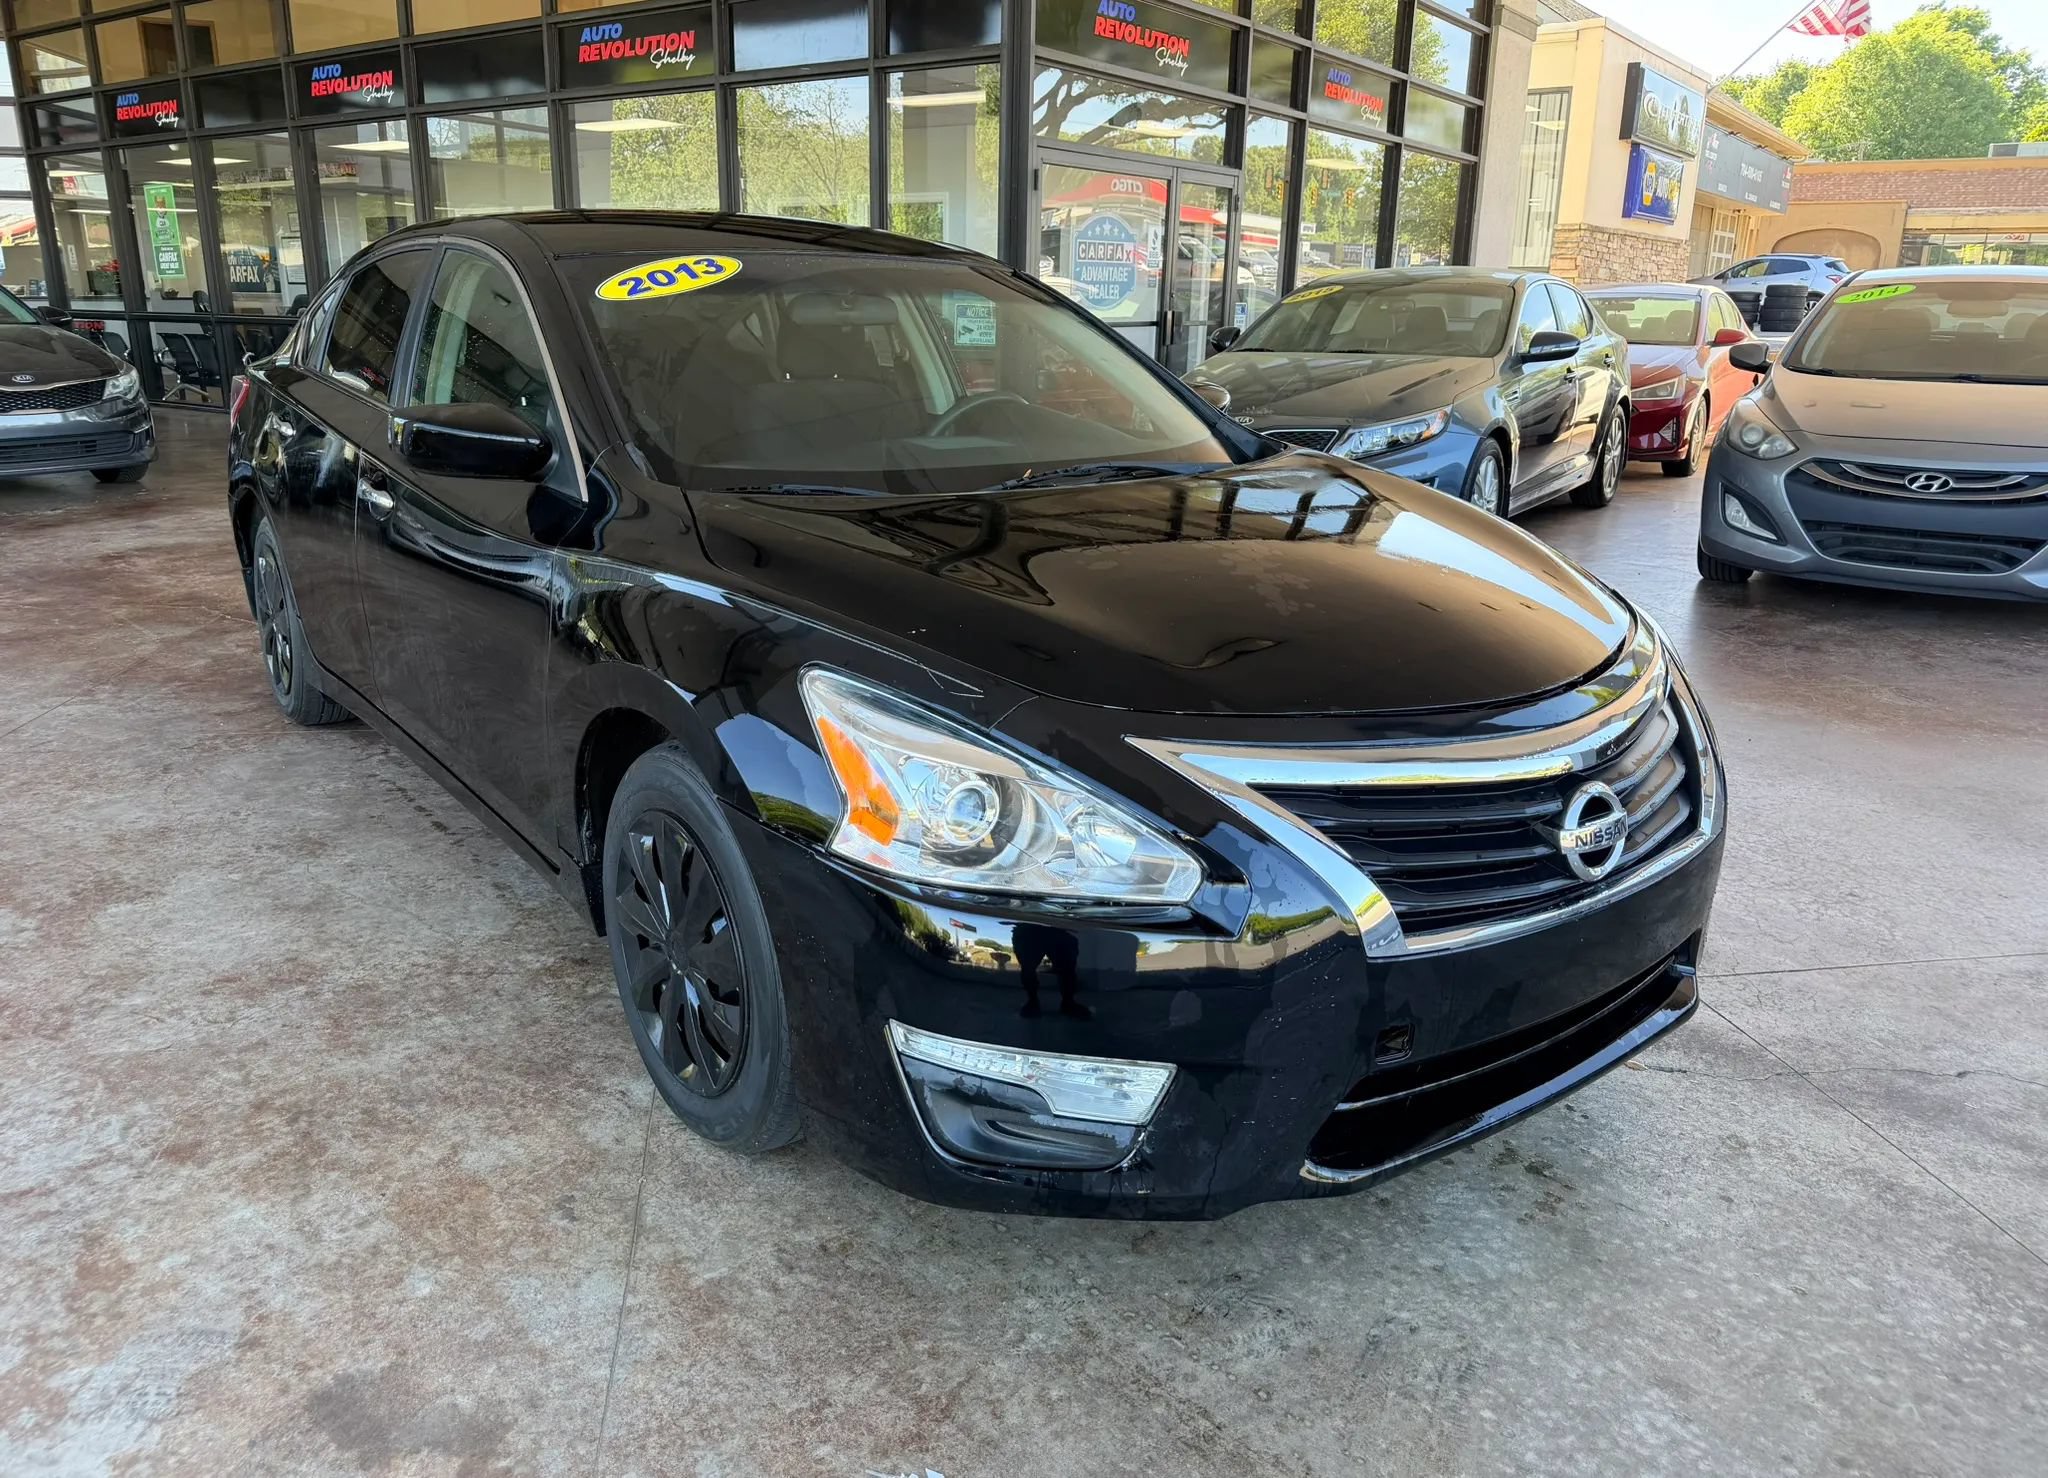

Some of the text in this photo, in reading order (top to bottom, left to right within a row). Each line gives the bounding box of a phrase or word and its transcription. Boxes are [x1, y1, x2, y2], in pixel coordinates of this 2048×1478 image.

[1098, 0, 1135, 21] AUTO
[581, 23, 622, 42] AUTO
[1094, 16, 1189, 57] REVOLUTION
[579, 30, 695, 62] REVOLUTION
[650, 44, 695, 70] Shelby
[1155, 46, 1188, 77] Shelby
[312, 64, 341, 80] AUTO
[1328, 68, 1351, 86] AUTO
[311, 70, 393, 97] REVOLUTION
[362, 83, 394, 104] Shelby
[117, 93, 139, 107] AUTO
[1325, 82, 1384, 112] REVOLUTION
[116, 100, 177, 120] REVOLUTION
[1079, 242, 1132, 262] CARFAX
[230, 266, 260, 283] ARFAX
[618, 258, 726, 297] 2013
[1081, 265, 1129, 281] ADVANTAGE
[1088, 283, 1119, 299] DEALER
[1850, 286, 1899, 301] 2014
[966, 306, 990, 317] NOTICE
[1575, 818, 1627, 848] NISSAN
